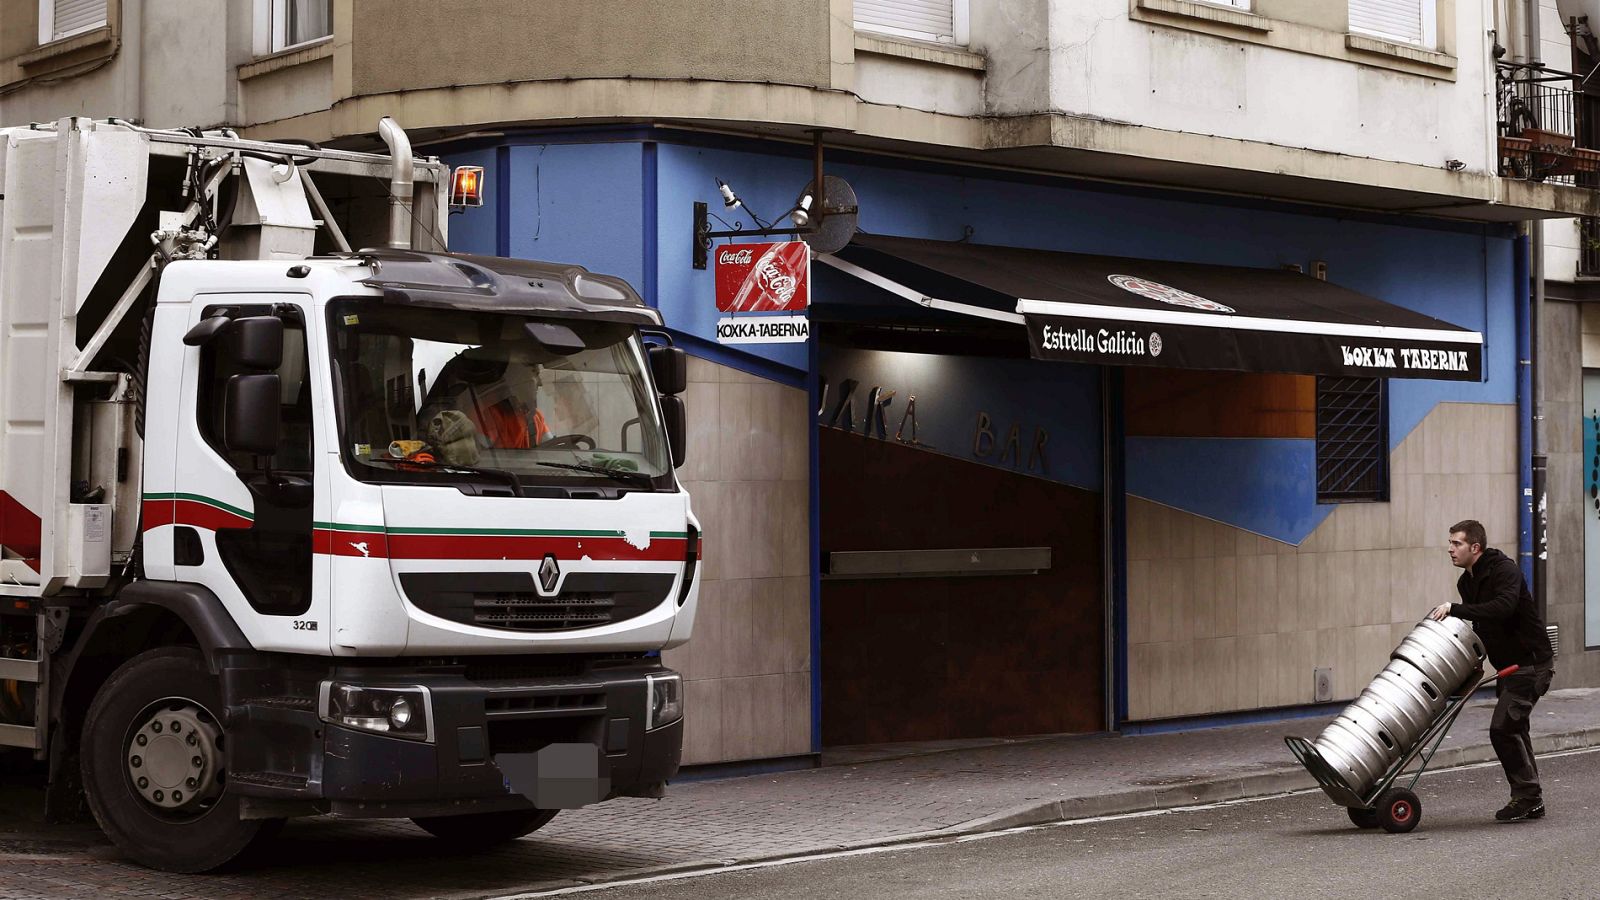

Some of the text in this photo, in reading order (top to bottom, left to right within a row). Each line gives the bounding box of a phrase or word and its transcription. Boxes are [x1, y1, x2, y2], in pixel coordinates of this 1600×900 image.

[719, 249, 754, 265] Coca-Cola
[716, 323, 808, 338] KOXKA-TABERNA
[1042, 324, 1095, 352] Estrella
[1097, 328, 1145, 355] Galicia
[1340, 345, 1469, 371] KOXKA TABERNA
[974, 411, 1049, 471] BAR
